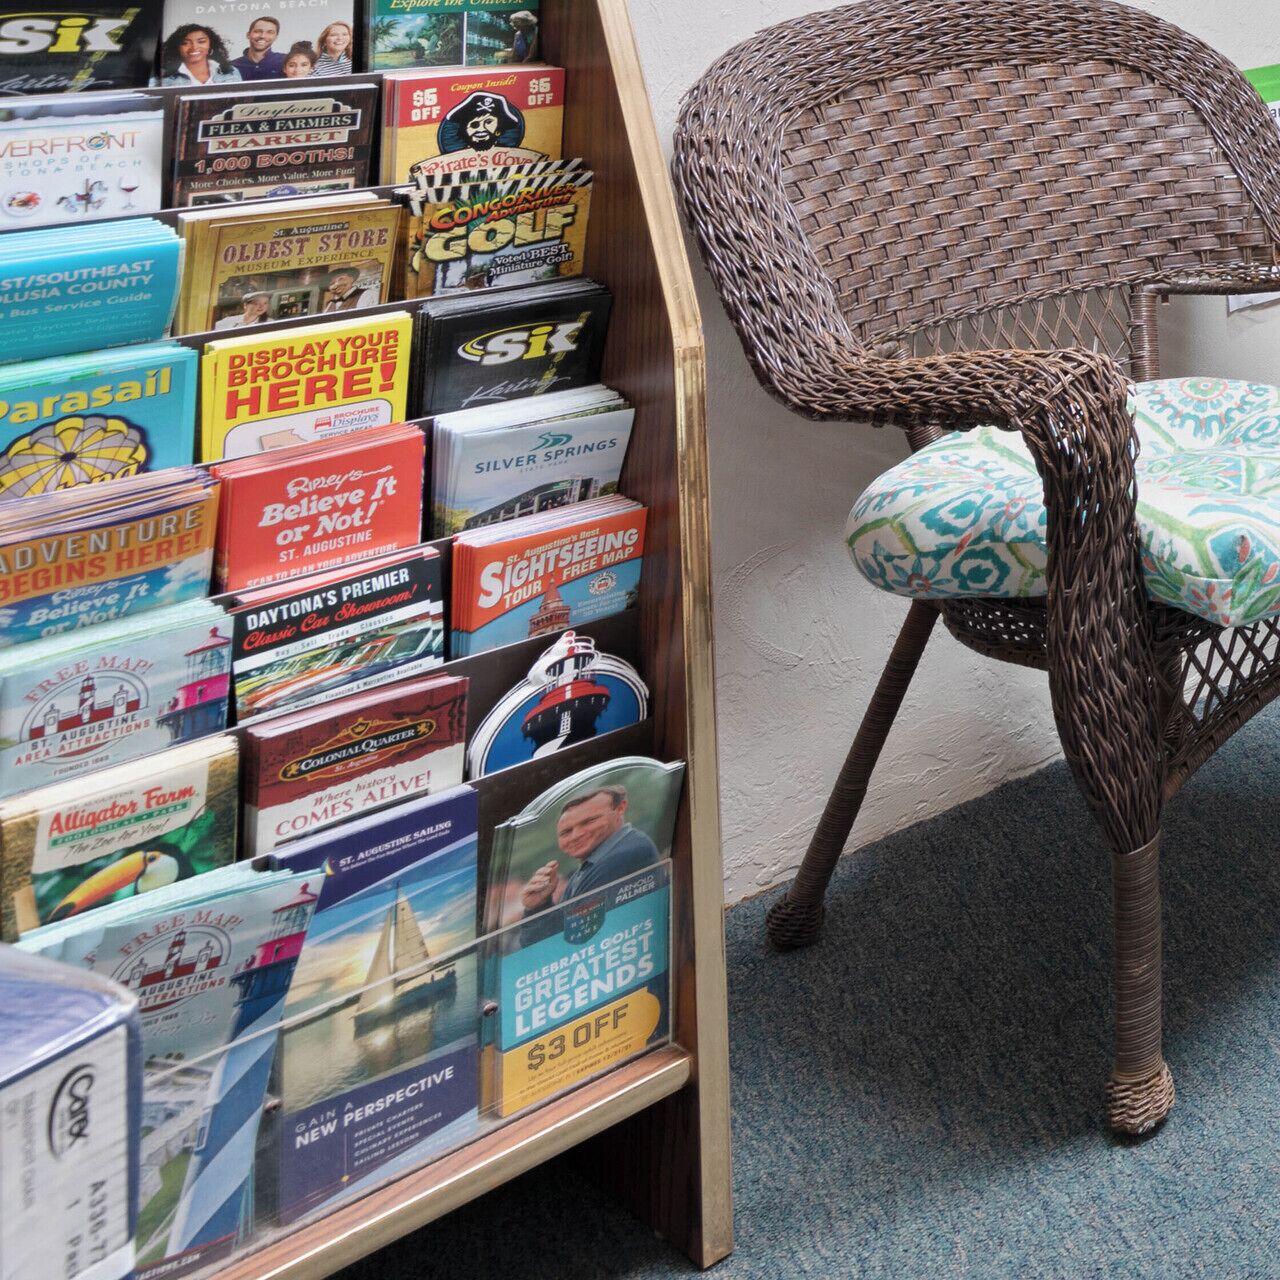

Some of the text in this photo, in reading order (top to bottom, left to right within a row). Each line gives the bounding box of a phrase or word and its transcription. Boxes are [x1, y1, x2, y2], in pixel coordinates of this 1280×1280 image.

[208, 115, 352, 135] FLEA & FARMERS
[216, 131, 347, 150] MARKET
[194, 147, 355, 173] 1,000 BOOTHS!
[222, 228, 389, 264] OLDEST STORE
[234, 248, 375, 274] MUSEUM EXPERIENCE
[9, 291, 153, 319] Bus Service Guide
[62, 274, 154, 299] COUNTY
[228, 330, 399, 369] DISPLAY YOUR
[228, 345, 398, 386] BROCHURE
[225, 362, 397, 420] HERE!
[474, 438, 617, 474] SILVER SPRINGS
[258, 476, 397, 528] Believe It
[276, 504, 377, 547] or Not!
[278, 529, 373, 562] ST. AUGUSTINE
[503, 547, 634, 608] TOUR FREE MAP
[246, 567, 410, 631] DAYTONA'S PREMIER
[15, 719, 151, 767] AREA ATTRACTIONS
[300, 728, 415, 773] COLONIAL QUARTER
[48, 786, 195, 836] Alligator Farm
[275, 771, 431, 837] COMES ALIVE!
[313, 775, 397, 807] Where history
[615, 882, 655, 905] PALMER
[617, 874, 654, 896] ARNOLD
[514, 931, 654, 1012] GREATEST
[516, 919, 653, 989] CELEBRATE GOLF'S
[515, 953, 654, 1038] LEGENDS
[527, 1034, 566, 1071] $3
[572, 1003, 629, 1048] OFF
[295, 1066, 454, 1149] NEW PERSPECTIVE
